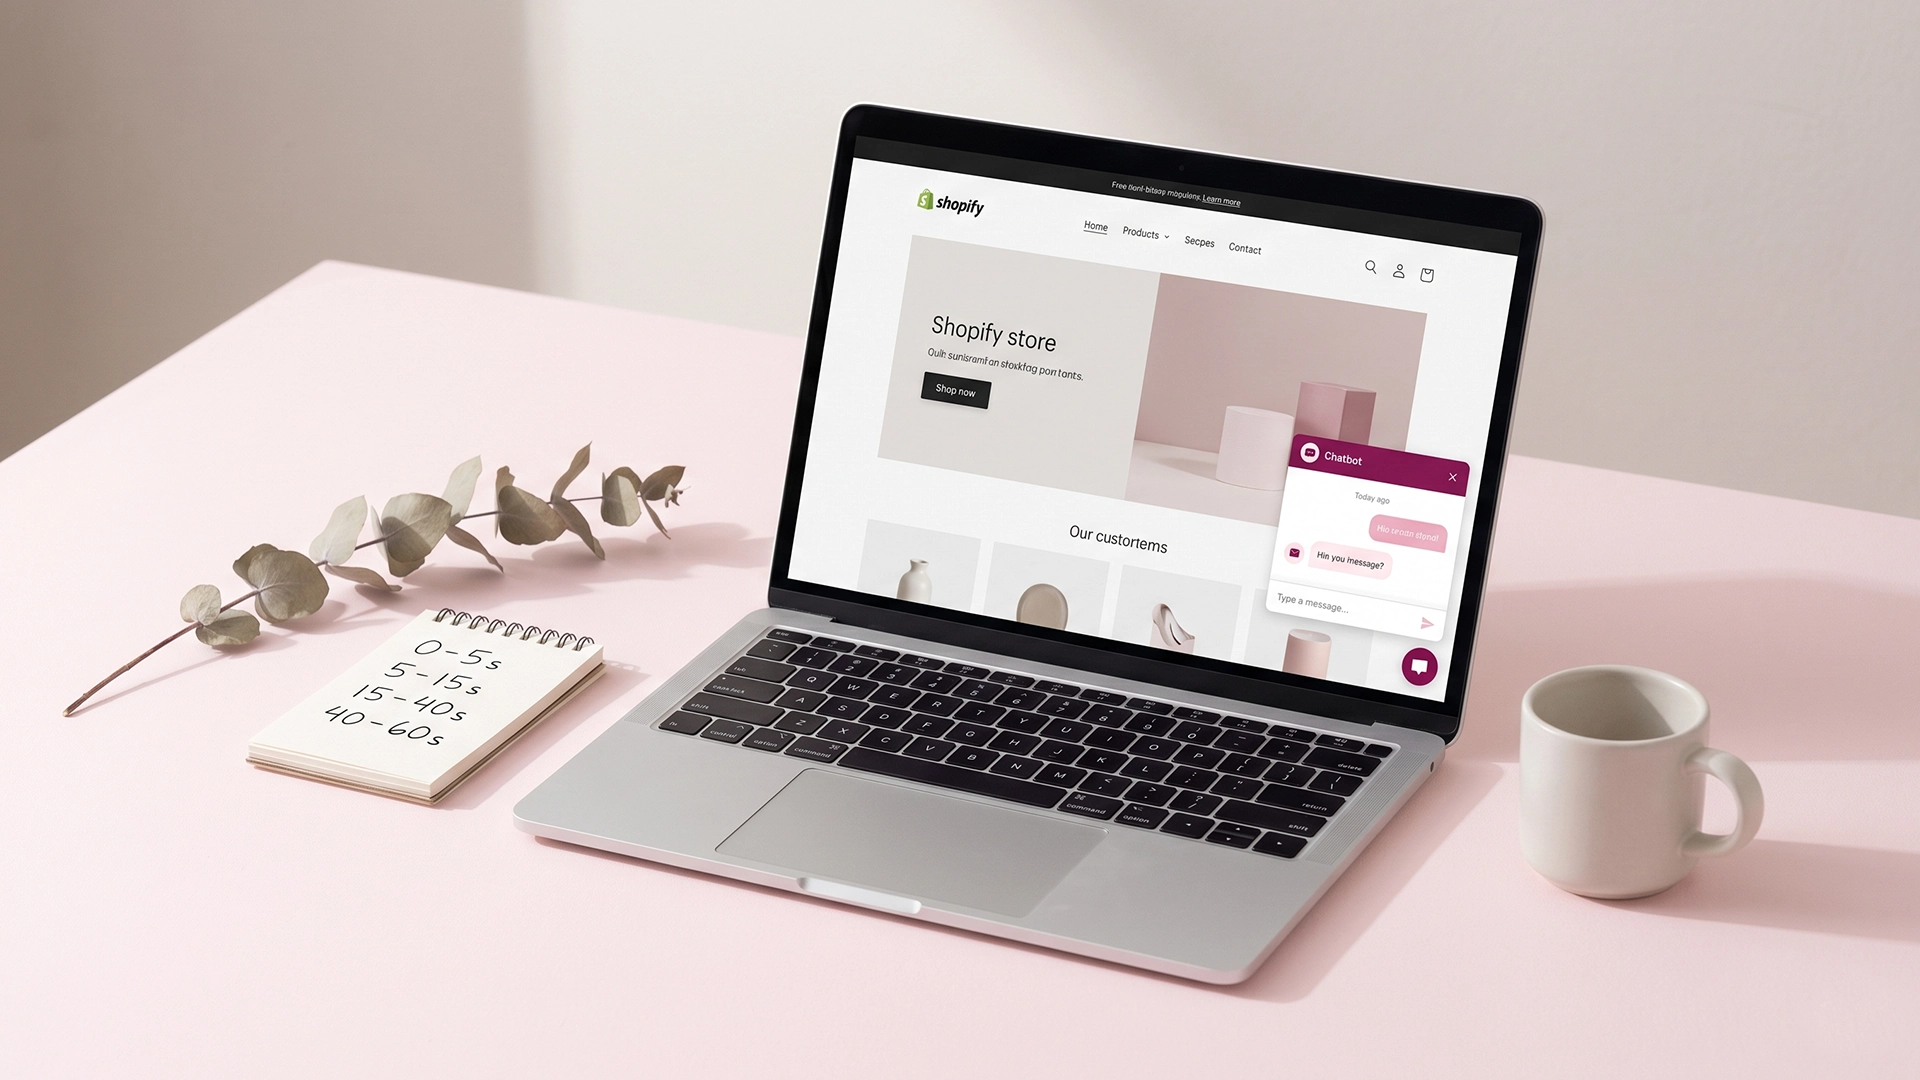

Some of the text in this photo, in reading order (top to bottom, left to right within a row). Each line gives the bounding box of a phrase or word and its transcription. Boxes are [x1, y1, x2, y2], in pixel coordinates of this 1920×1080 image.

[1111, 181, 1127, 190] Free
[1201, 194, 1222, 204] Learn
[1222, 198, 1241, 207] more
[935, 195, 985, 218] shopify
[1083, 220, 1109, 233] Home
[1122, 225, 1160, 240] Products
[1184, 235, 1216, 249] Secpes
[1228, 242, 1262, 255] Contact
[931, 315, 1057, 352] Shopify store
[935, 383, 977, 398] Shop now
[1323, 451, 1363, 466] Chatbot
[1354, 491, 1391, 505] Today ago
[1069, 524, 1094, 540] Our
[1316, 550, 1330, 560] Hin
[1331, 553, 1346, 563] you
[1277, 592, 1297, 605] Type
[1304, 600, 1349, 614] message...
[847, 683, 861, 691] W
[889, 692, 900, 700] E
[969, 689, 980, 697] 5
[837, 704, 848, 712] S
[931, 700, 942, 708] R
[837, 727, 849, 735] X
[965, 730, 976, 738] G
[1061, 726, 1072, 734] U
[880, 736, 891, 744] C
[1008, 738, 1021, 746] H
[925, 744, 936, 752] V
[1096, 756, 1107, 764] K
[1141, 765, 1149, 773] L
[1337, 762, 1363, 772] delete
[1053, 771, 1067, 779] M
[1066, 803, 1107, 815] command
[1301, 802, 1328, 812] return
